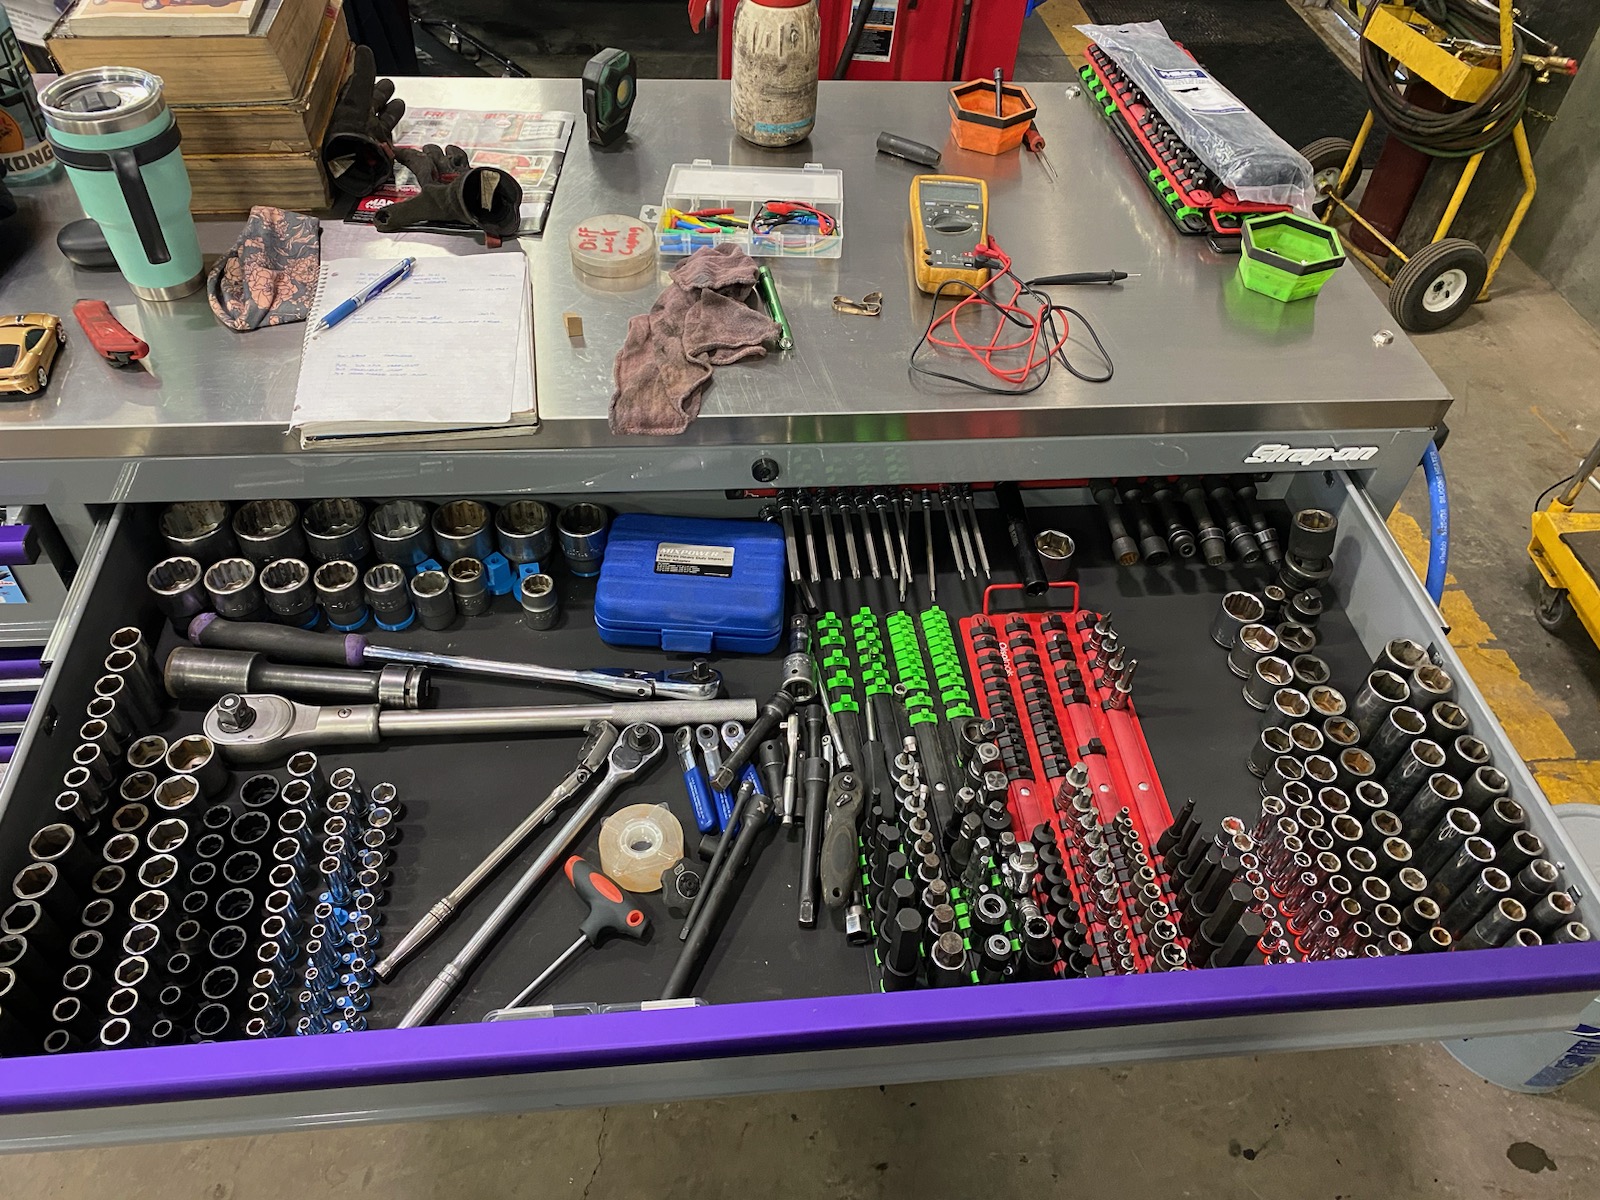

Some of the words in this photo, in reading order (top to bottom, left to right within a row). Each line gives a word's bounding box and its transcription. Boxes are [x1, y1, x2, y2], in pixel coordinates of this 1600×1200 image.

[1243, 443, 1380, 466] Snap-on
[1430, 451, 1441, 475] HEATER
[1436, 475, 1446, 504] SILICONE
[660, 548, 719, 557] MIXPOWER
